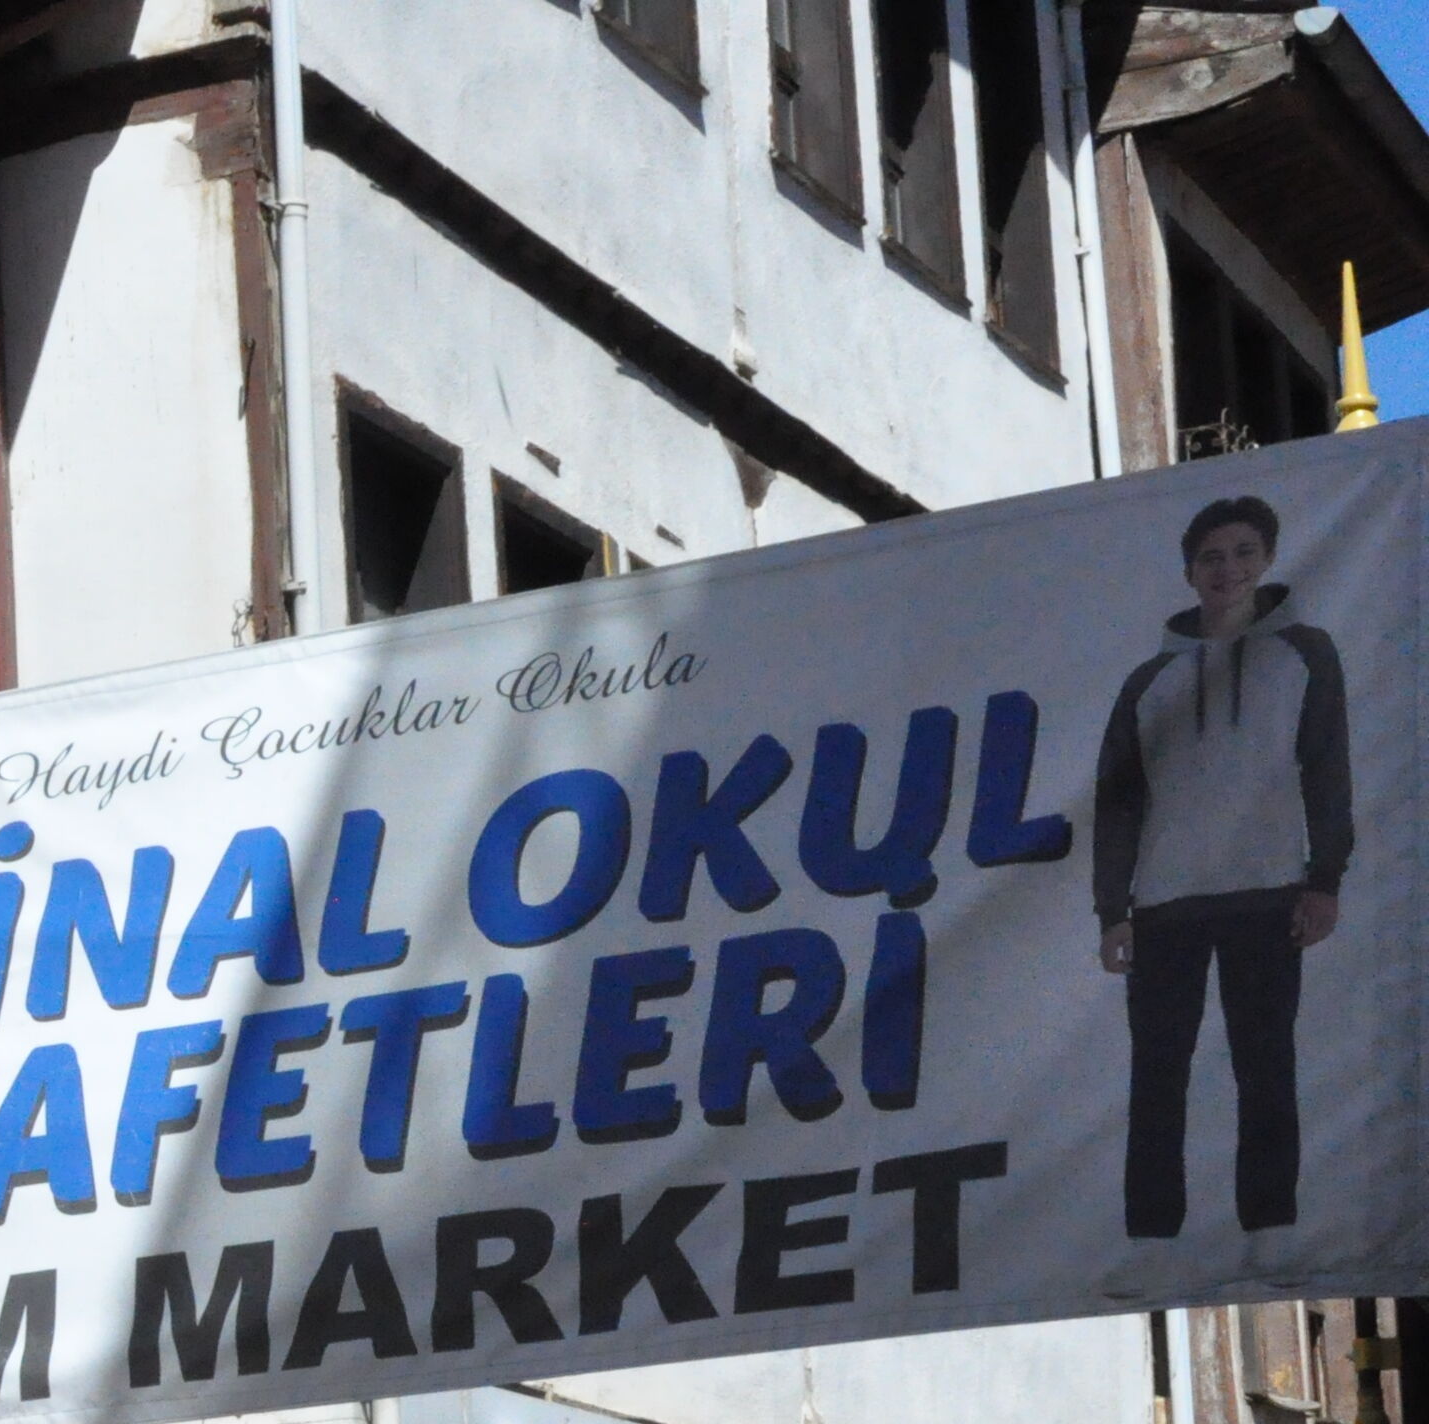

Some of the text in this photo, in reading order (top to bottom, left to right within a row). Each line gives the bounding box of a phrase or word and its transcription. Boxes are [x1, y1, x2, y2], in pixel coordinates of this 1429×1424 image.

[201, 678, 481, 780] Çocuklar
[496, 632, 709, 714] Okula
[465, 688, 1077, 950] OKUL
[128, 1140, 1009, 1390] MARKET
